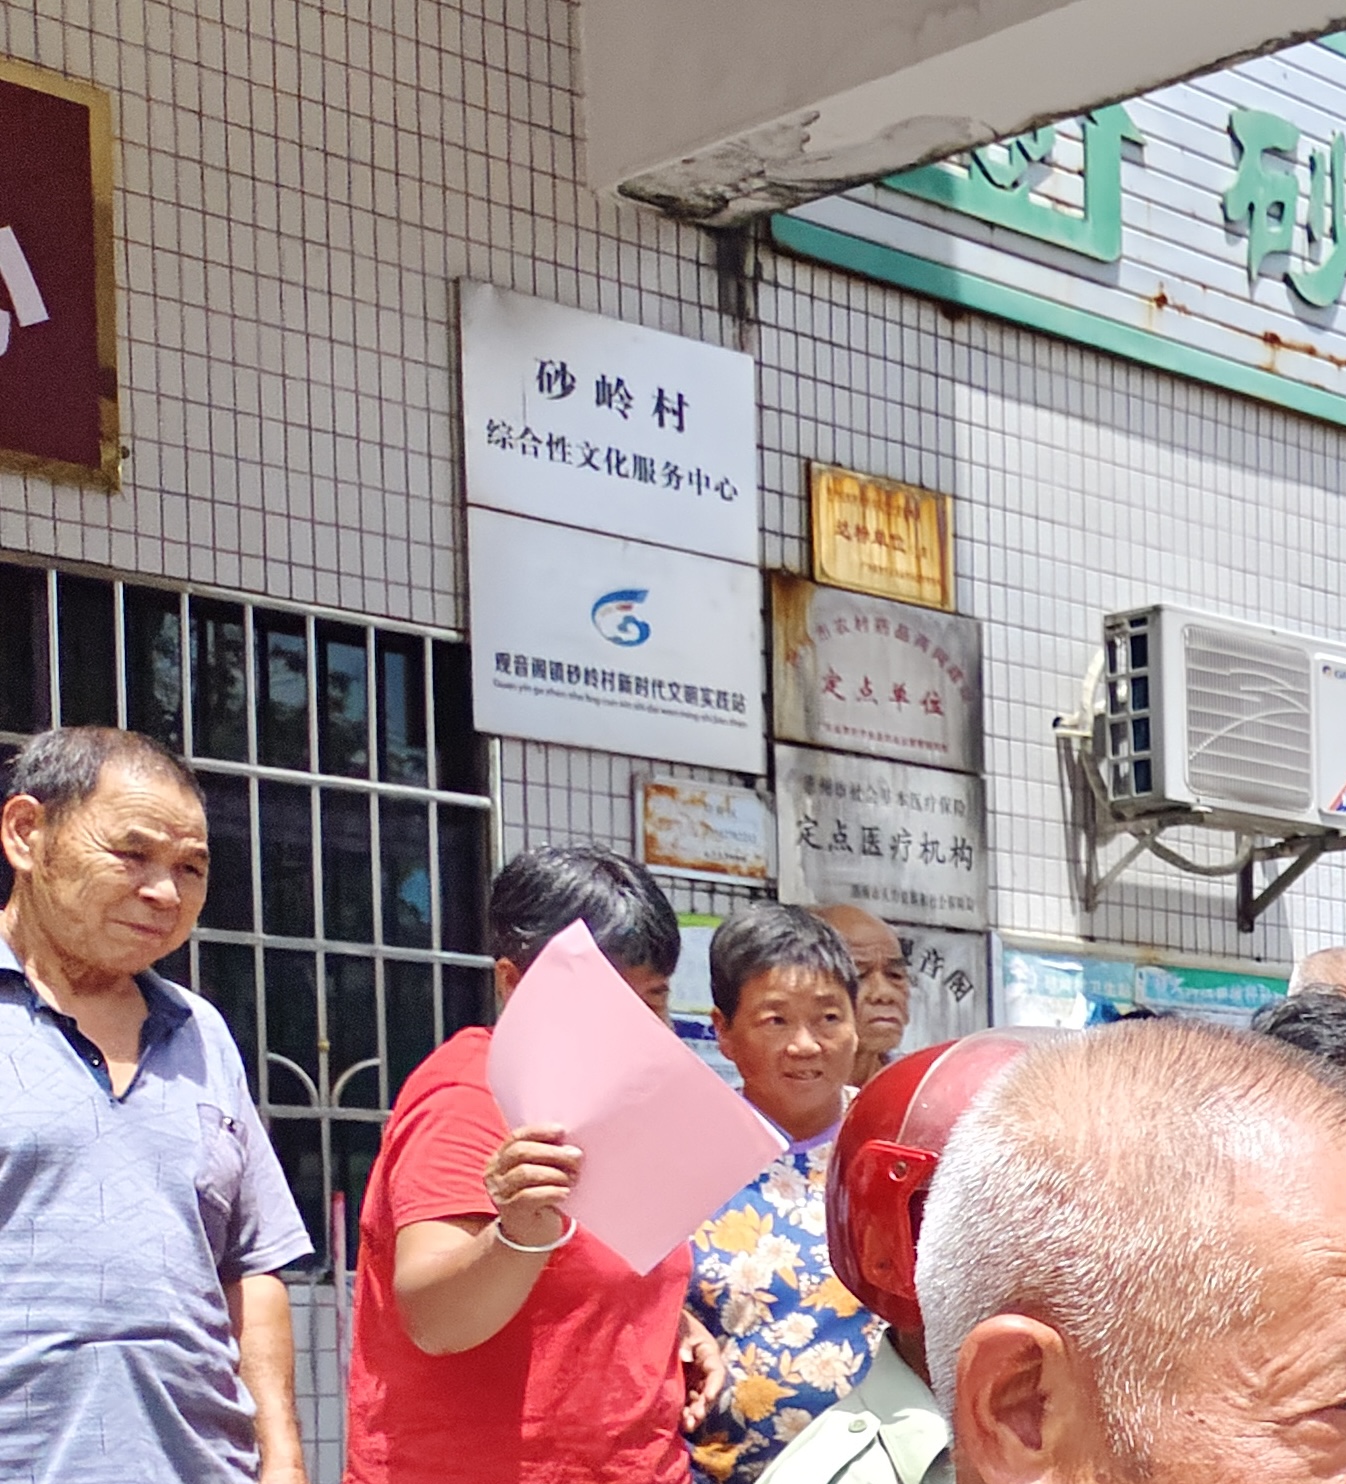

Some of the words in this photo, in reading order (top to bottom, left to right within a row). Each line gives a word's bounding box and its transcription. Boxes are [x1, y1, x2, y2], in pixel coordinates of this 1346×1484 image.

[533, 356, 690, 434] 砂岭村
[485, 417, 739, 502] 综合性文化服务中心
[821, 666, 945, 717] 定点单位
[796, 813, 974, 872] 定点医疗机构
